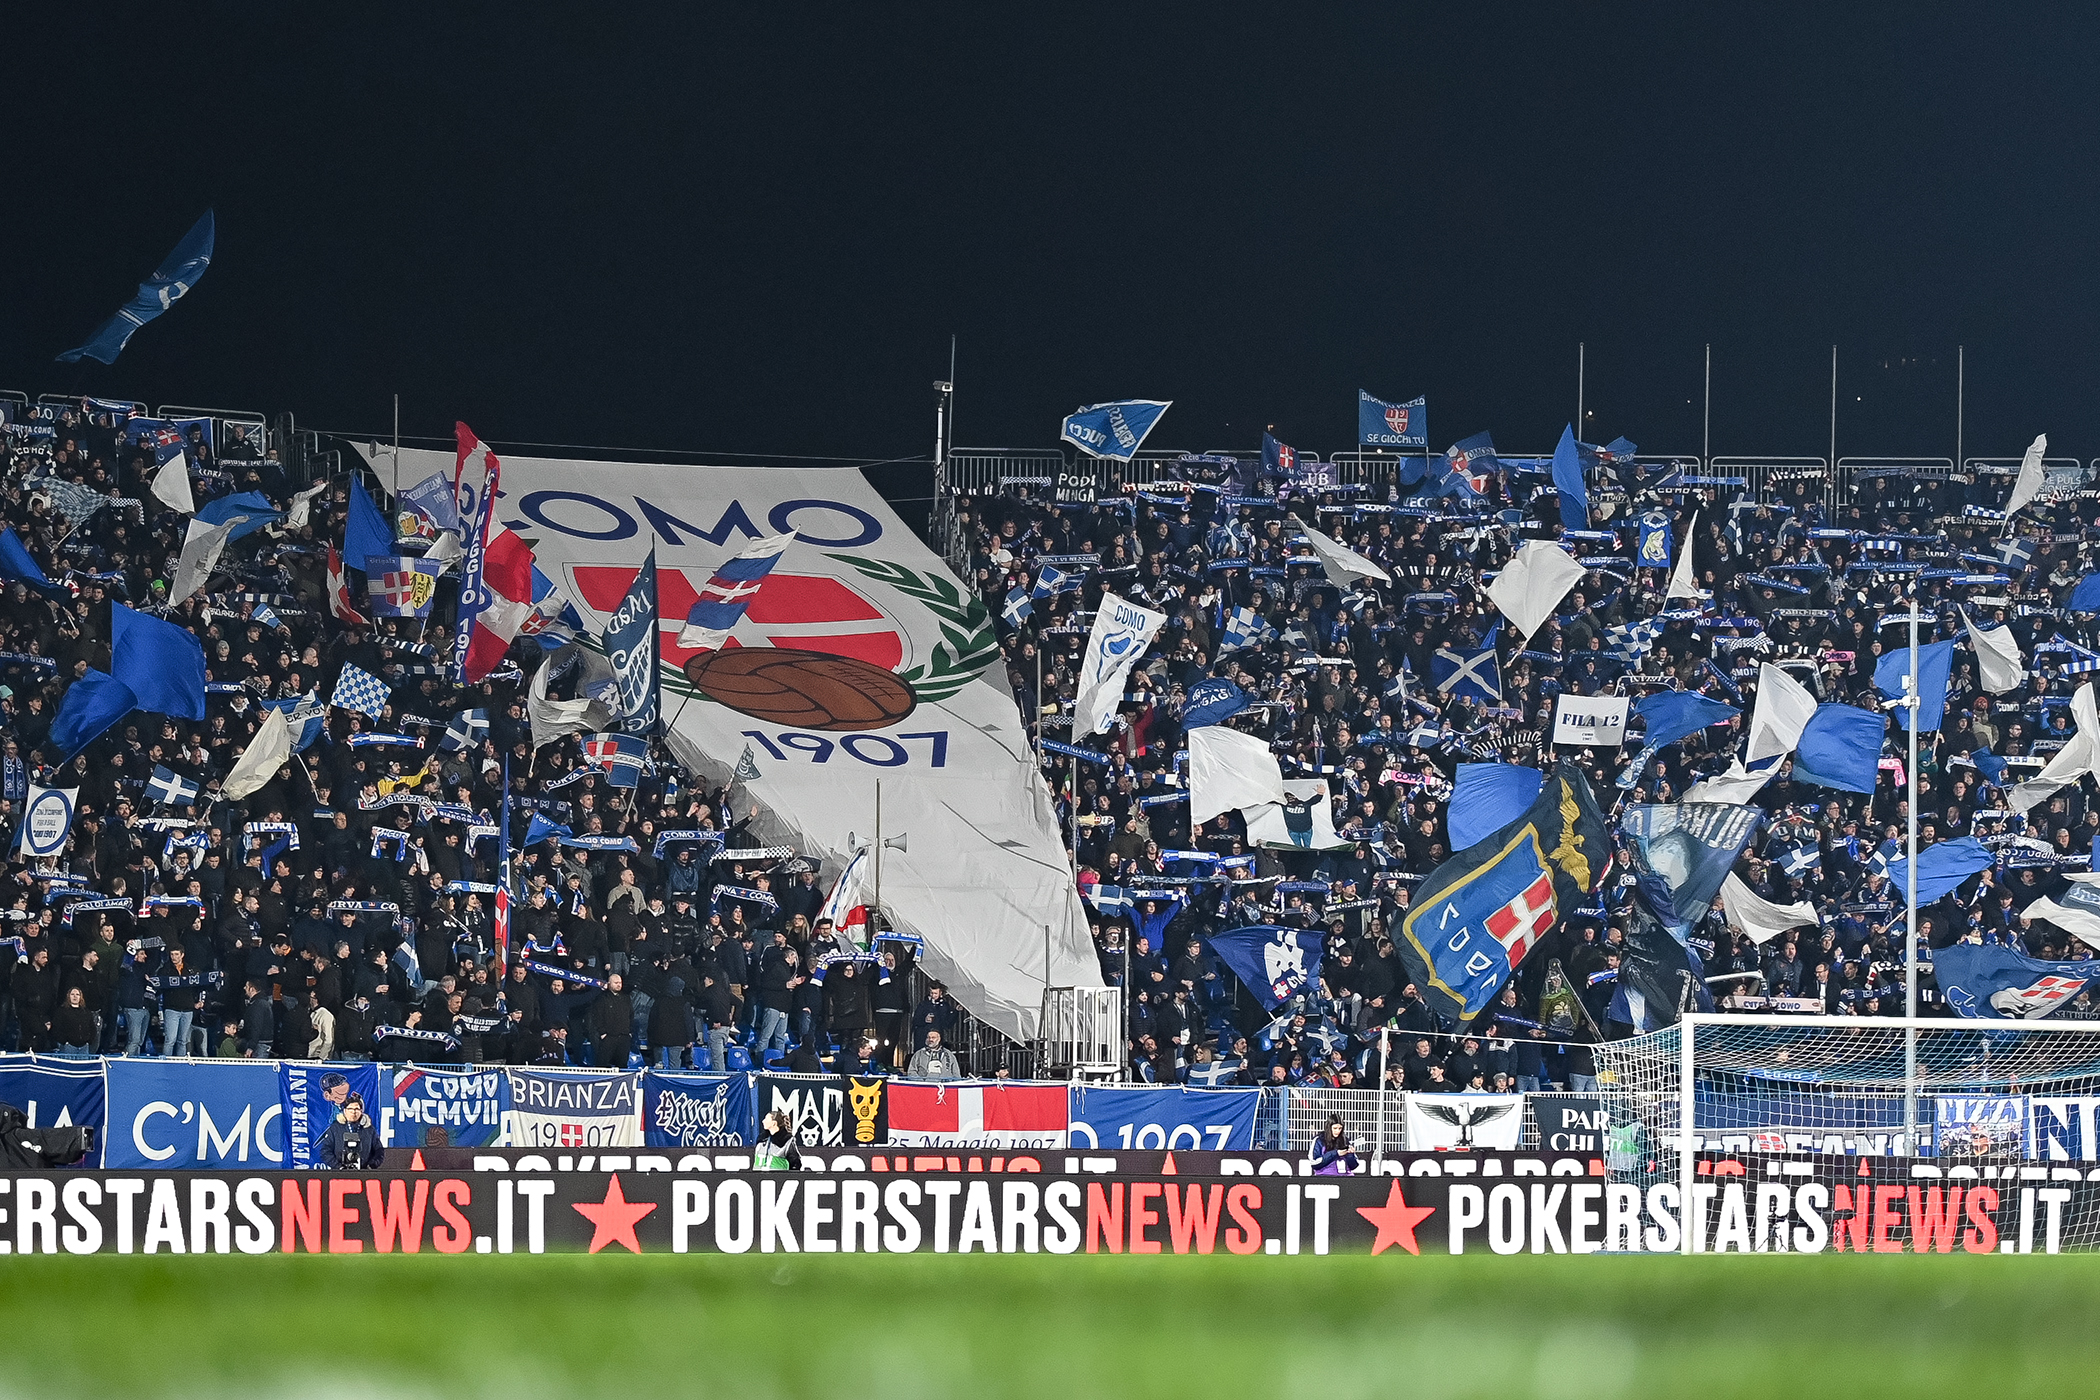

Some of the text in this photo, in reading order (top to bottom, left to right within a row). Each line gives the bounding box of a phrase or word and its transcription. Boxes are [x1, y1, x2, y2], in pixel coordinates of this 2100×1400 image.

[1366, 433, 1425, 445] SE GIOCHI TU
[16, 446, 44, 455] COMO
[1056, 488, 1095, 502] MINGA
[1363, 503, 1392, 512] COMO
[1944, 516, 1966, 525] PESI
[461, 511, 486, 605] MAGGIO
[1114, 604, 1147, 632] COMO
[1669, 610, 1699, 620] COMO
[453, 618, 472, 681] 1907
[1562, 713, 1620, 727] FILA 12
[741, 730, 949, 768] 1907
[546, 772, 581, 786] CURVA
[600, 837, 623, 846] COMO
[663, 831, 695, 840] COMO
[1986, 832, 2015, 842] OMO
[748, 890, 776, 904] COMO
[534, 962, 565, 976] COMO
[424, 1073, 498, 1100] COMO
[512, 1076, 632, 1110] BRIANZA
[398, 1096, 499, 1126] MCMVII
[289, 1069, 308, 1170] VETERANI
[529, 1121, 617, 1148] 19 07
[671, 1179, 1340, 1256] POKERSTARSNEWS.IT
